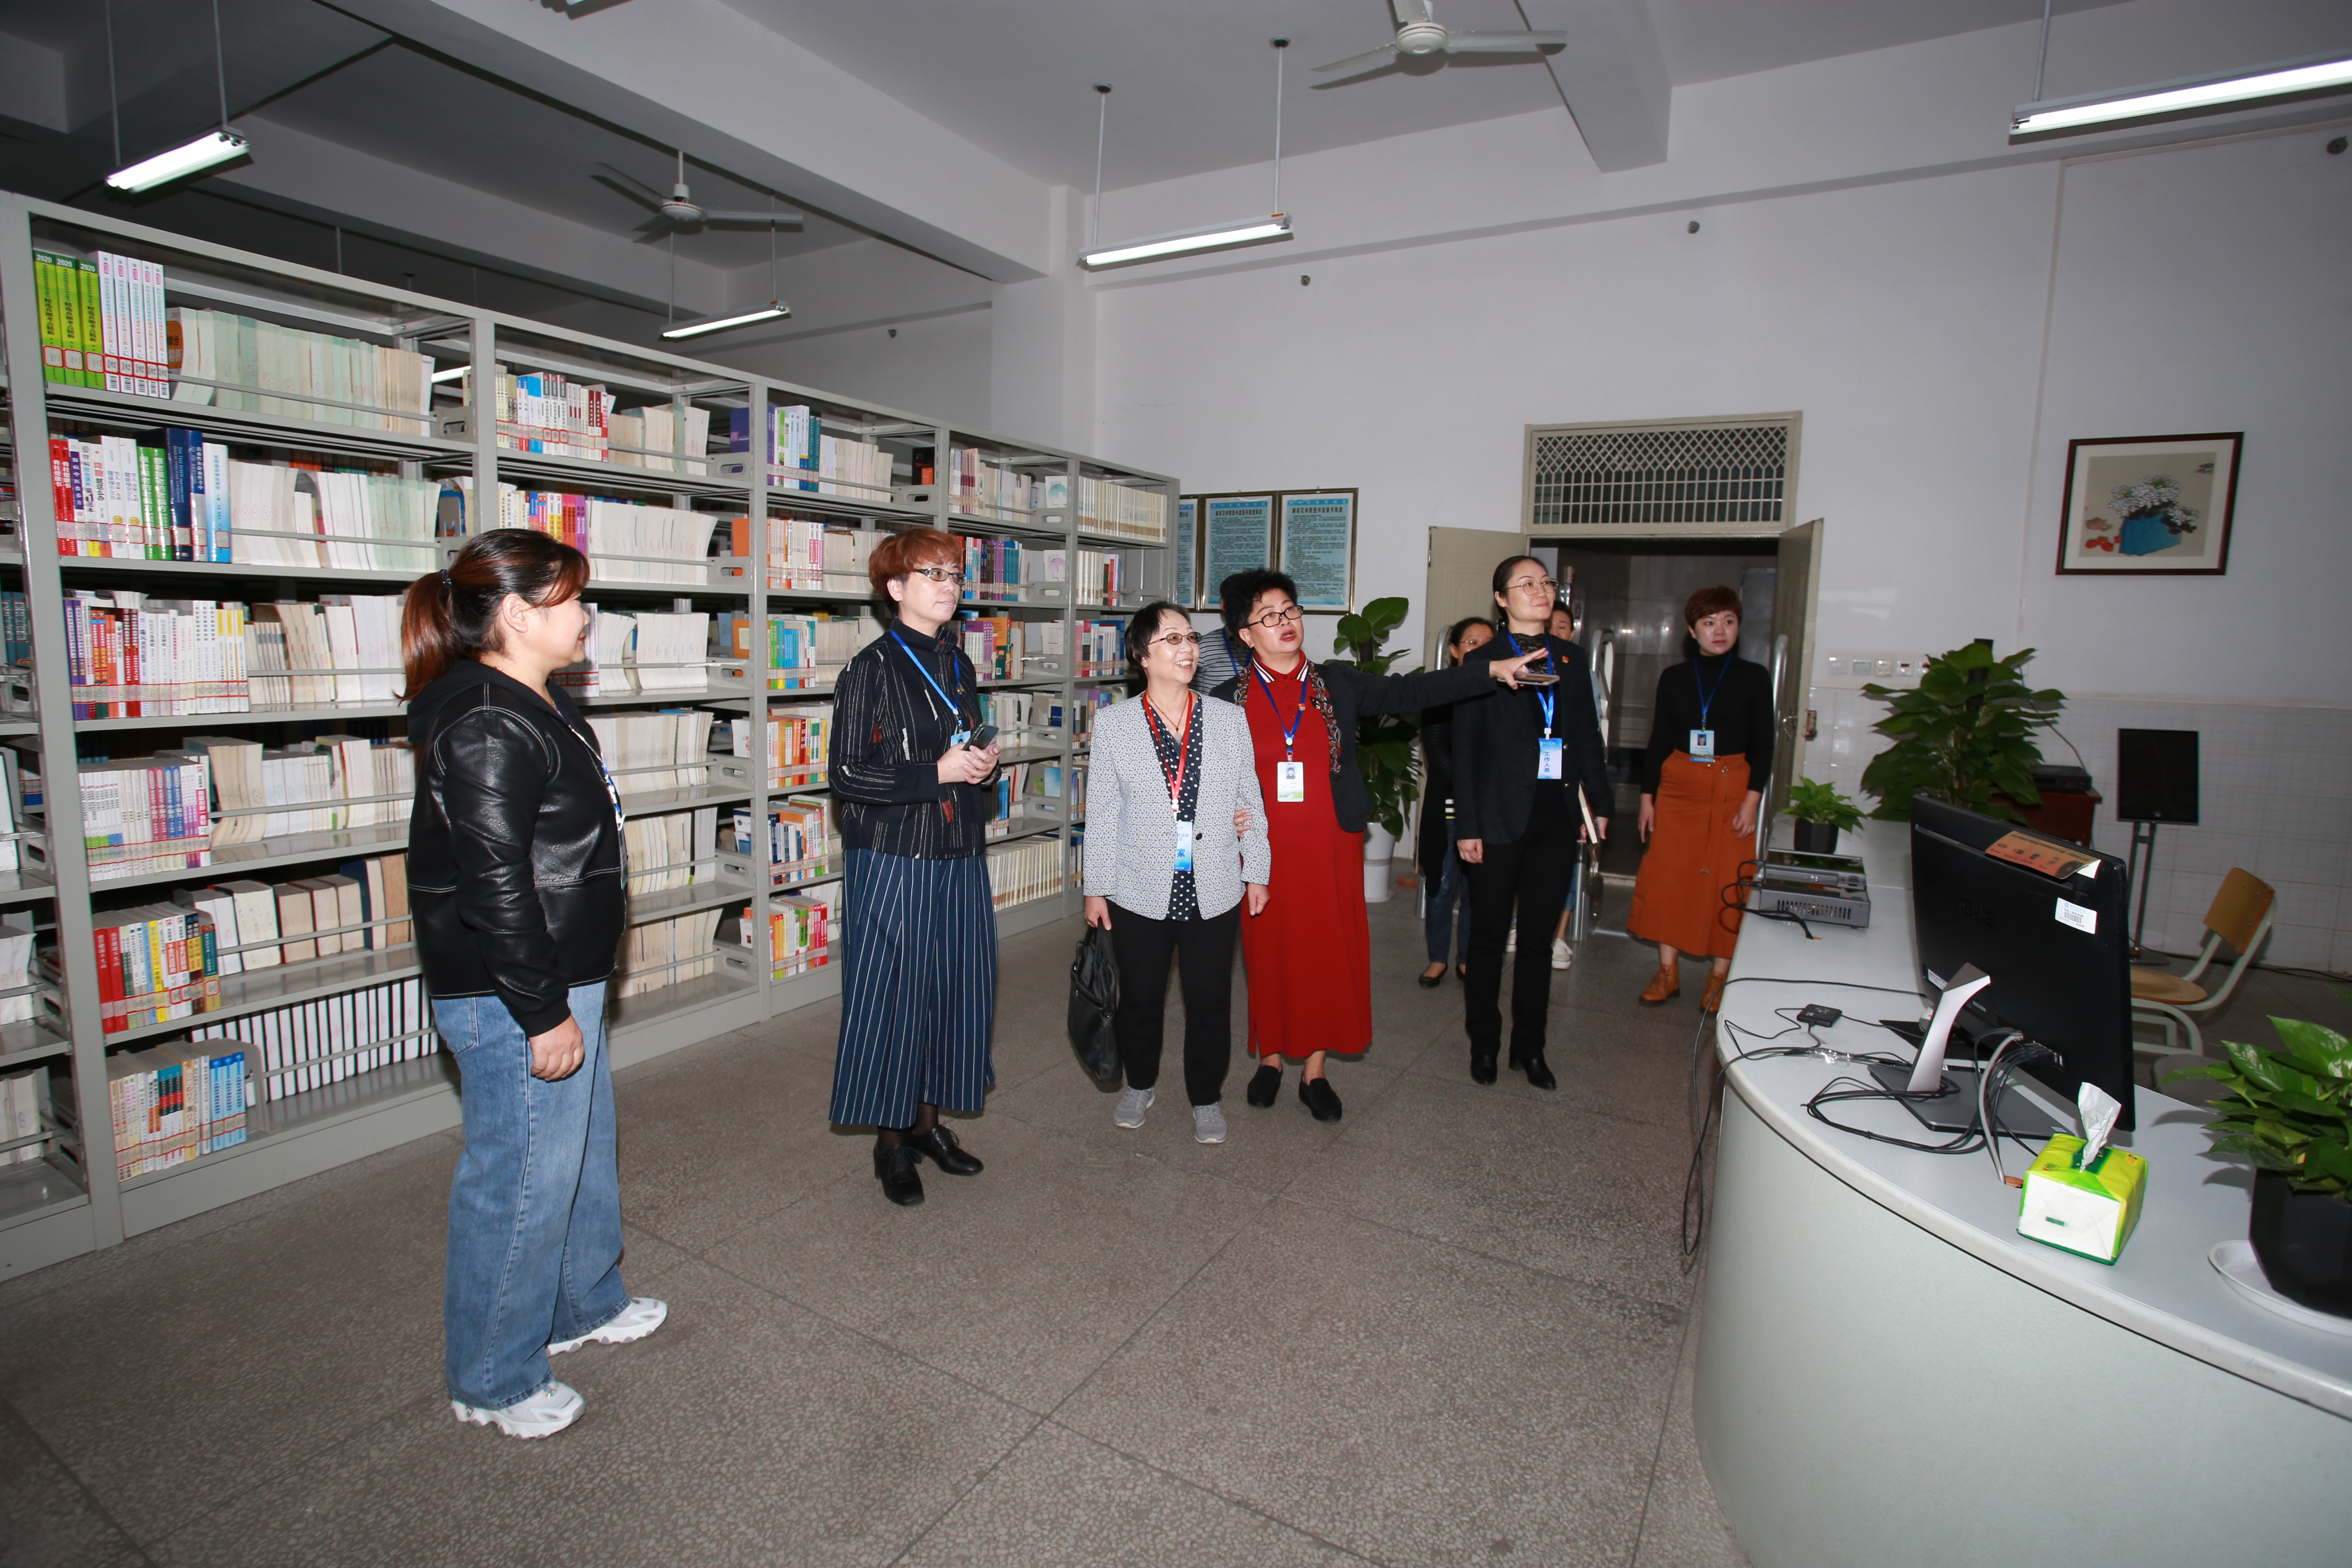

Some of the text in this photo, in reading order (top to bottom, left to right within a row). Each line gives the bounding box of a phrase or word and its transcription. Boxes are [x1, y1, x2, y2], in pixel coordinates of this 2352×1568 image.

[37, 254, 52, 263] 2020
[57, 258, 72, 267] 2020
[80, 263, 95, 272] 2020
